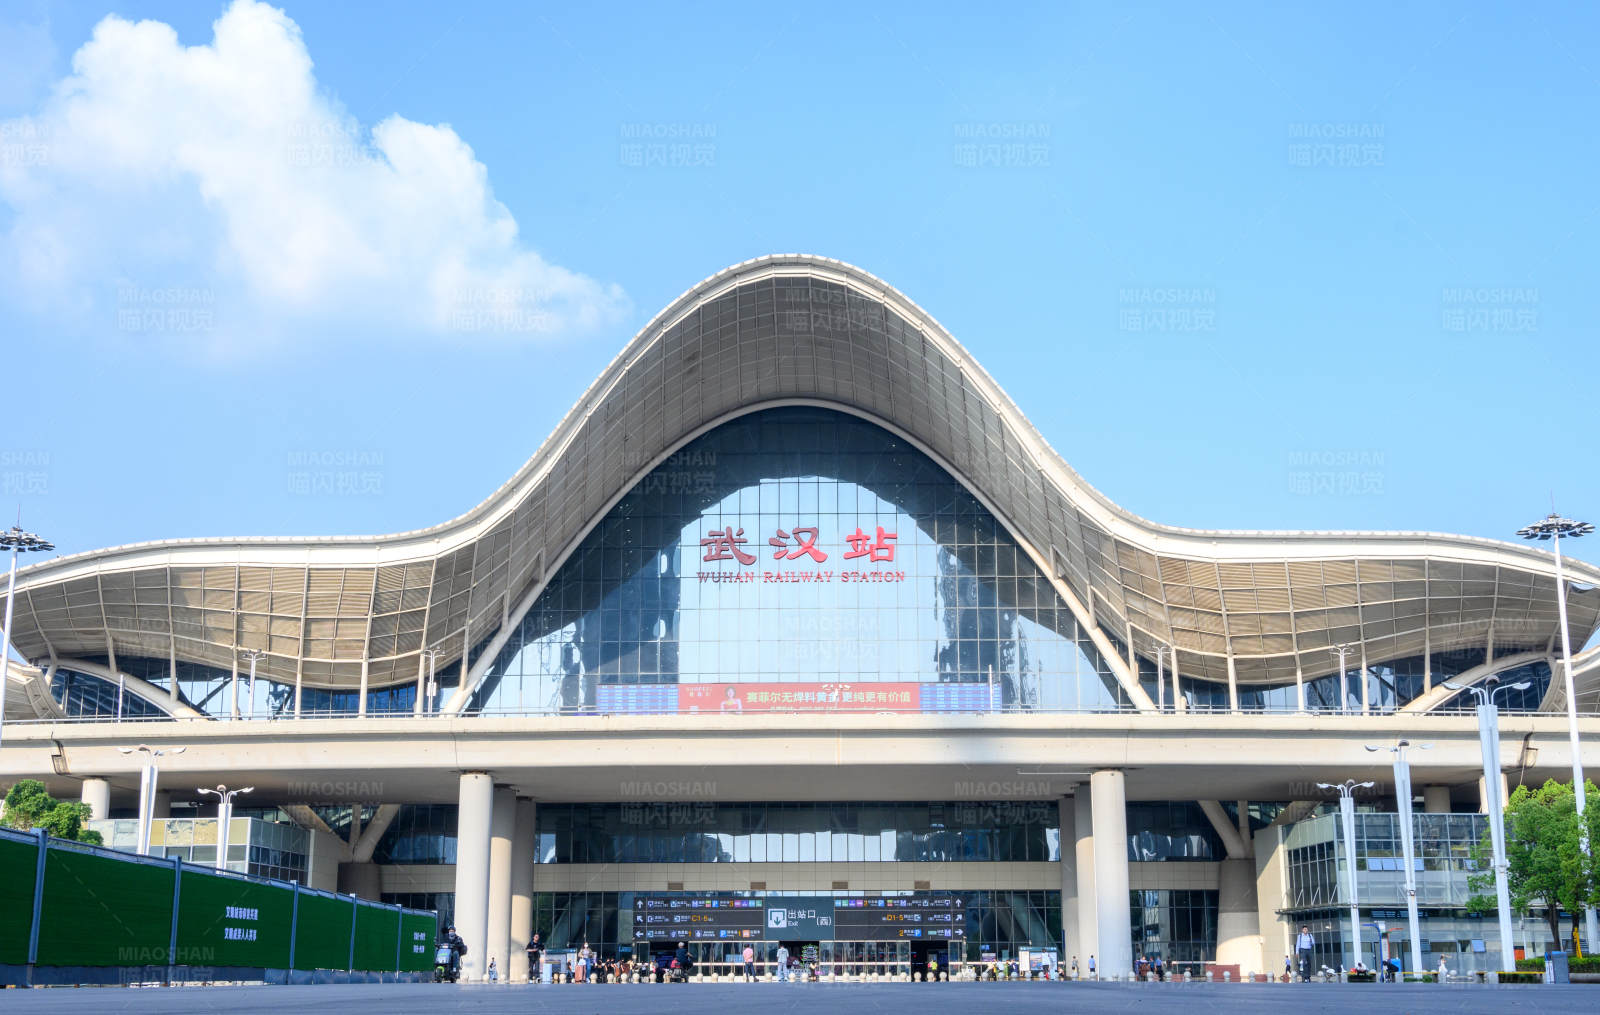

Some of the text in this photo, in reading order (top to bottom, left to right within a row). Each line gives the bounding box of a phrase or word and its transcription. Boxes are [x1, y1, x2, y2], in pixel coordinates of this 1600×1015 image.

[699, 525, 898, 566] 武汉站
[696, 570, 905, 584] WUHAN RAILWAY STATION
[787, 908, 816, 920] 出站口
